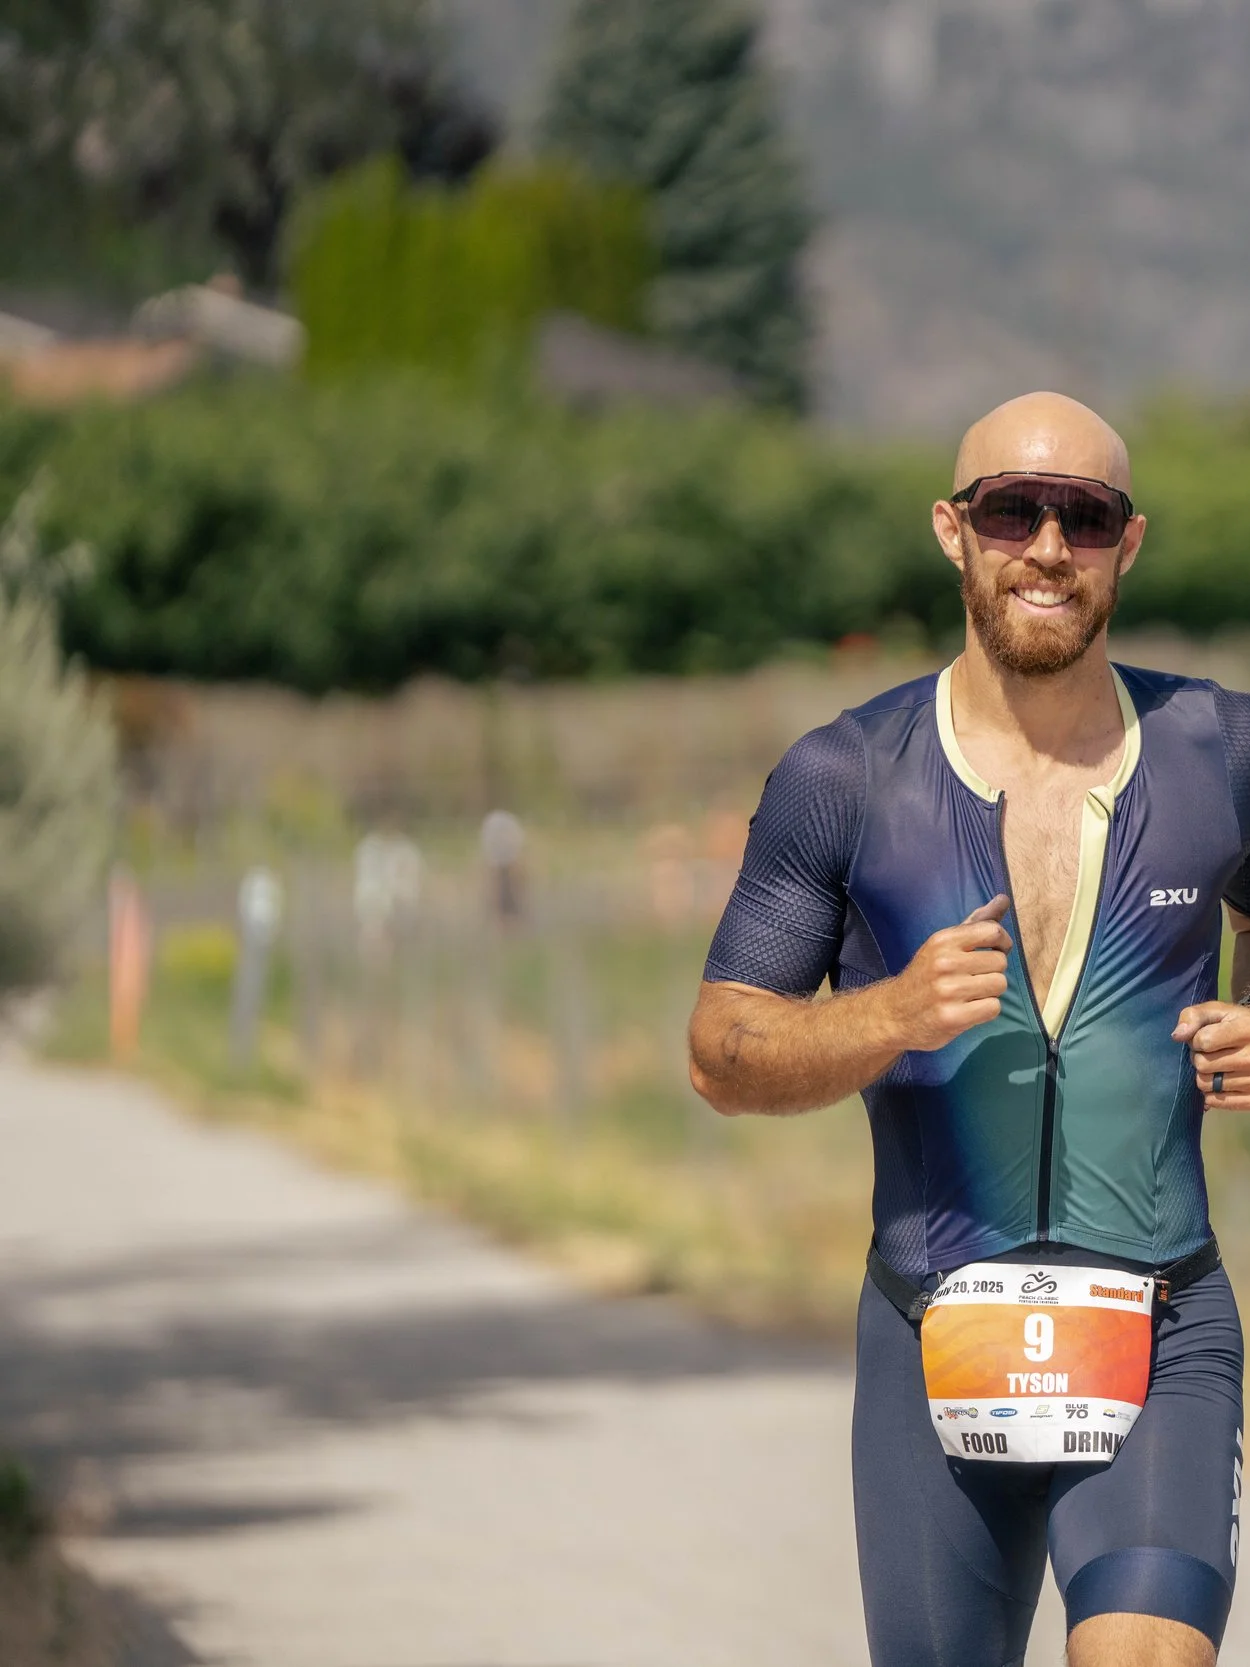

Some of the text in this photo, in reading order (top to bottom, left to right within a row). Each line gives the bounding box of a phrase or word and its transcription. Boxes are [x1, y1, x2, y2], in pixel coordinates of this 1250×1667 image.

[1149, 887, 1198, 906] 2XU
[952, 1281, 970, 1294] 20,
[973, 1280, 1004, 1294] 2025
[1089, 1283, 1143, 1304] Standard
[1023, 1312, 1055, 1362] 9
[1006, 1372, 1069, 1394] TYSON
[1065, 1409, 1089, 1419] 70
[961, 1432, 1008, 1454] FOOD
